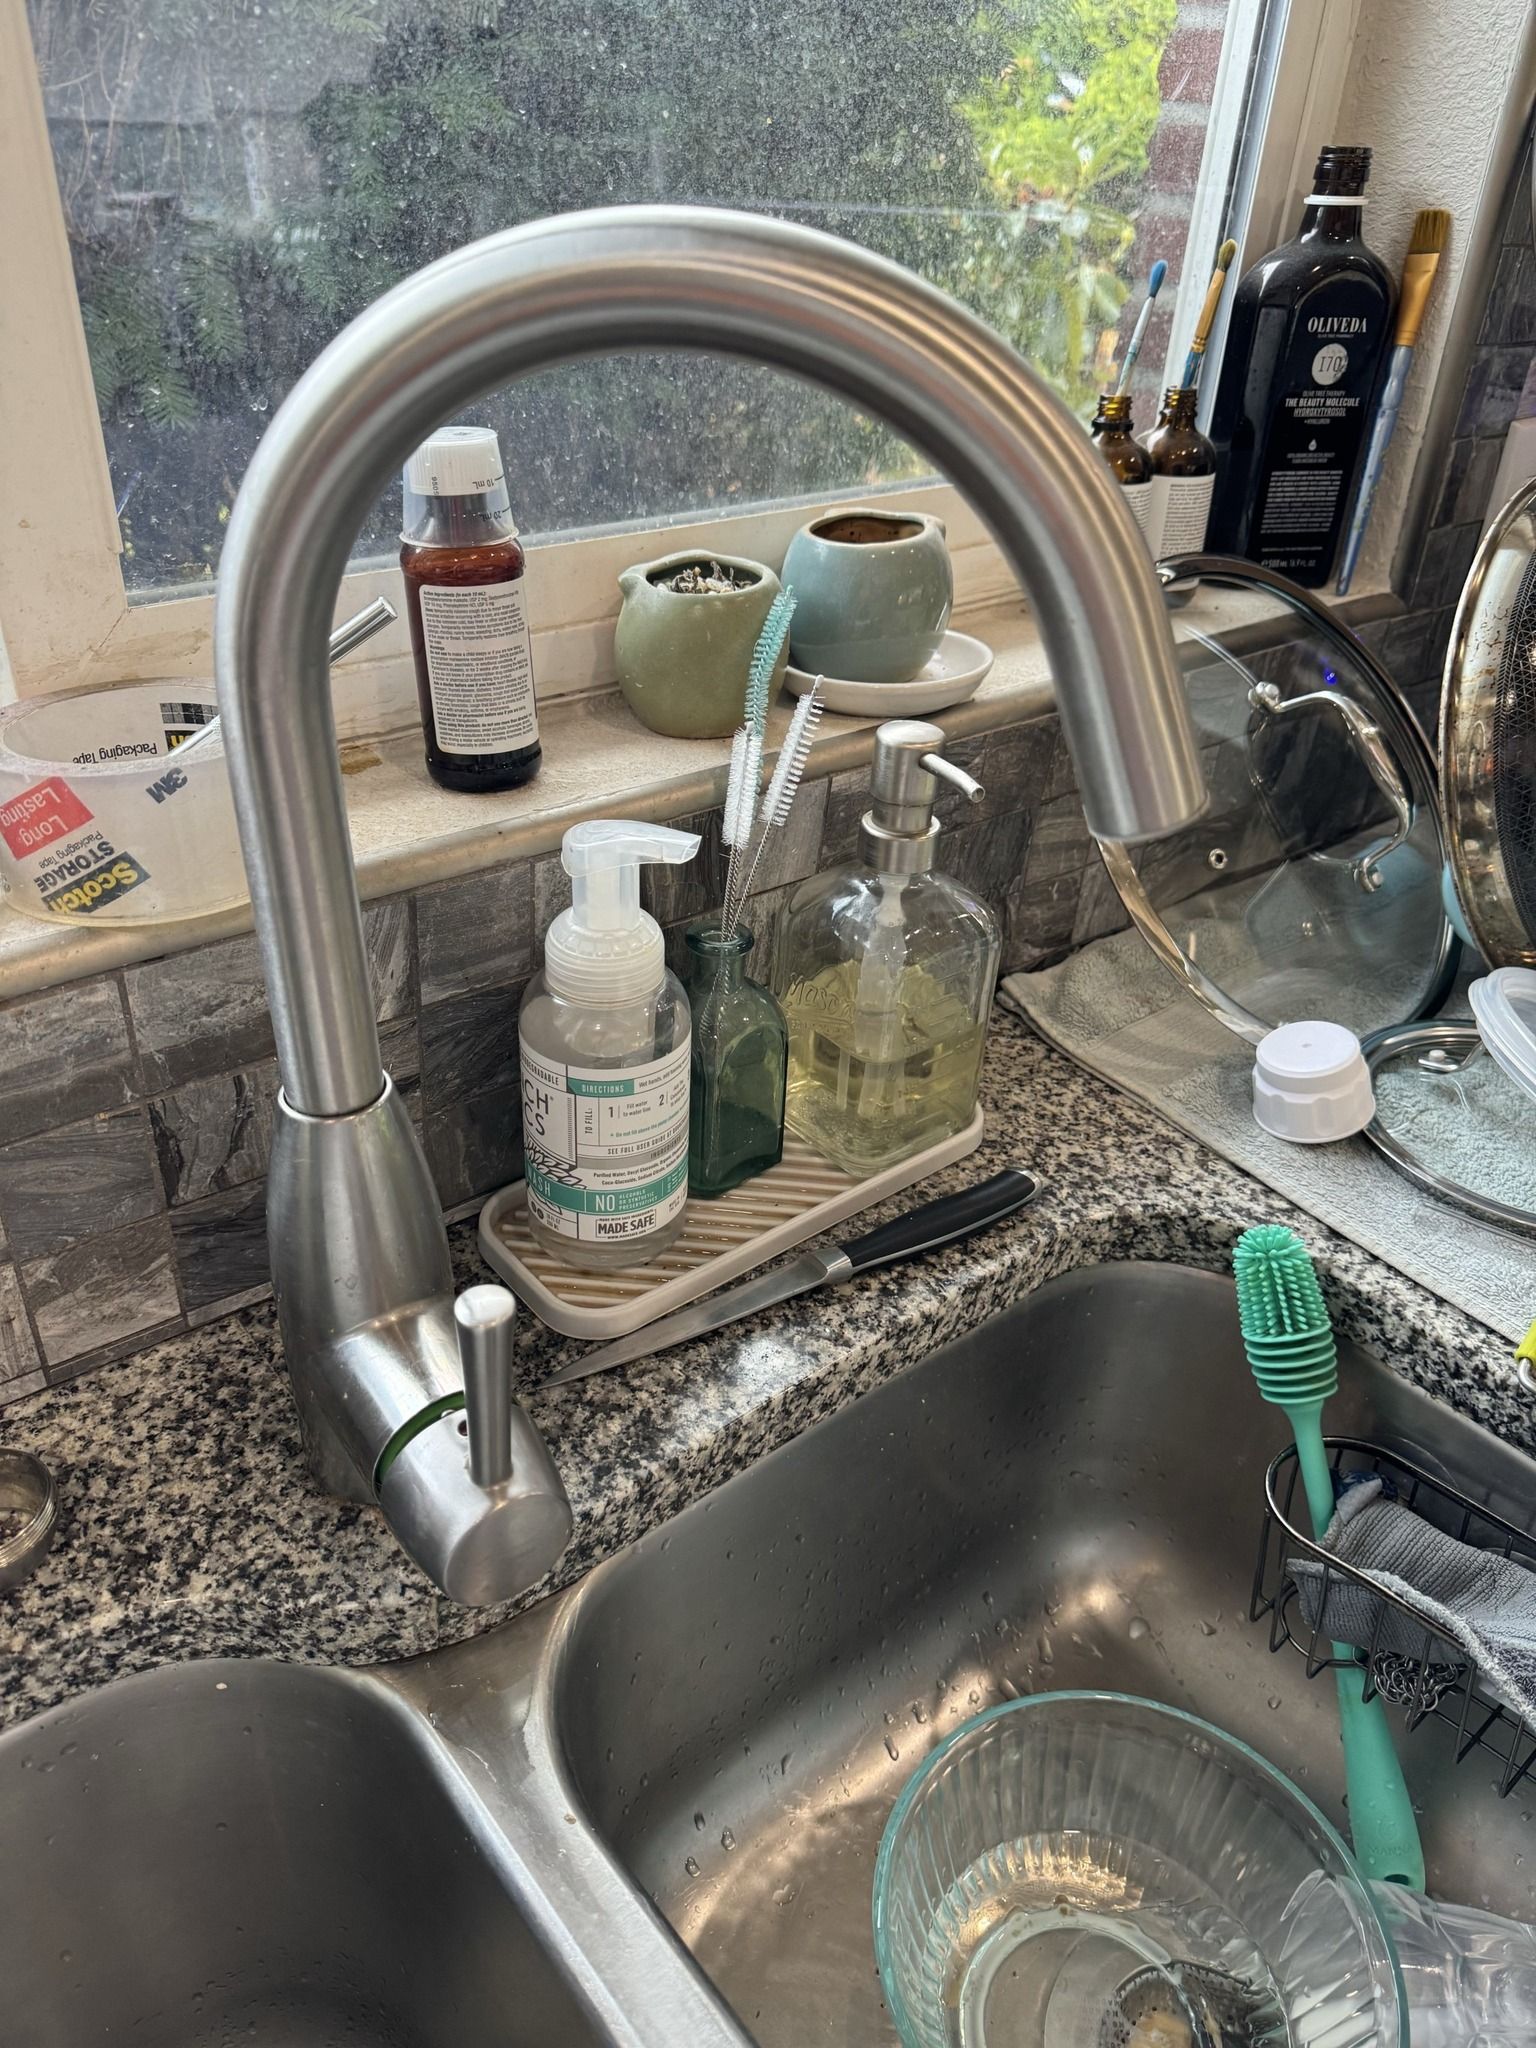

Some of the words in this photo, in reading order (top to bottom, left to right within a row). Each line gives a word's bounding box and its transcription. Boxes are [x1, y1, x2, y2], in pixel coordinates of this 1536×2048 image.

[1307, 316, 1367, 333] OLIVEDA
[1285, 398, 1298, 407] THE
[1299, 398, 1325, 407] BEAUTY
[1325, 397, 1360, 407] MOLECULE
[486, 478, 495, 488] 10
[493, 510, 502, 520] 20
[72, 750, 98, 764] Tape
[99, 742, 158, 761] Packaging
[144, 767, 188, 804] 3M
[0, 786, 61, 827] Lasting
[19, 814, 68, 847] Long
[56, 831, 104, 859] Packaging
[33, 840, 116, 893] STORAGE
[39, 852, 60, 870] Tape
[49, 861, 139, 915] Scotch
[581, 1084, 625, 1094] DIRECTIONS
[659, 1094, 665, 1106] 2
[584, 1107, 593, 1125] FILL:
[608, 1106, 614, 1118] 1
[584, 1126, 593, 1134] TO
[620, 1146, 634, 1154] FULL
[636, 1141, 650, 1150] USER
[651, 1135, 666, 1146] GUIDE
[595, 1194, 616, 1212] NO
[597, 1221, 629, 1235] MADE
[630, 1213, 655, 1231] SAFE
